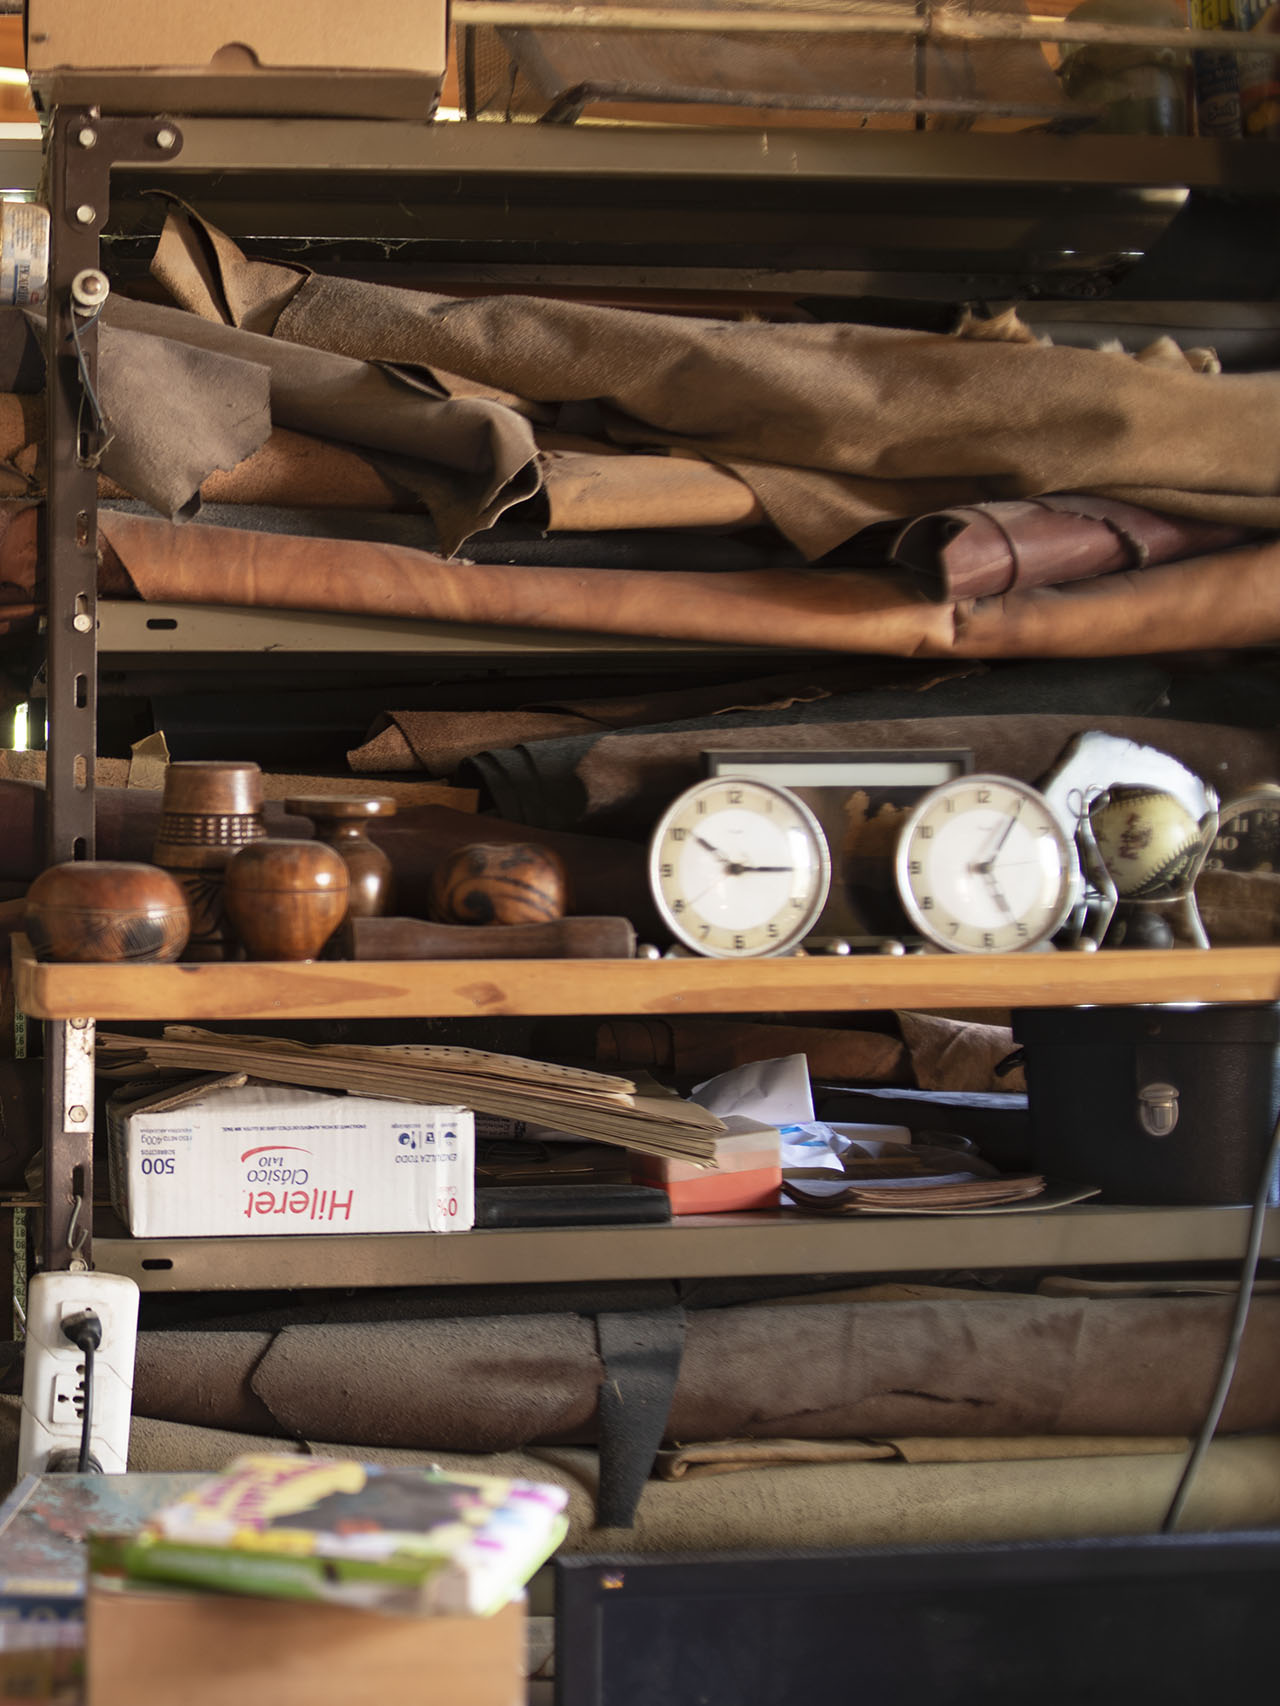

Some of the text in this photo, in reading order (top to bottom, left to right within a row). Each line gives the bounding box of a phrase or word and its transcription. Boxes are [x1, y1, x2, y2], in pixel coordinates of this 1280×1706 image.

[1215, 836, 1239, 851] 10
[140, 1133, 163, 1146] 400g
[141, 1158, 176, 1175] 500
[394, 1153, 419, 1164] TODO
[247, 1168, 309, 1186] Clásico
[243, 1188, 354, 1221] Hileret
